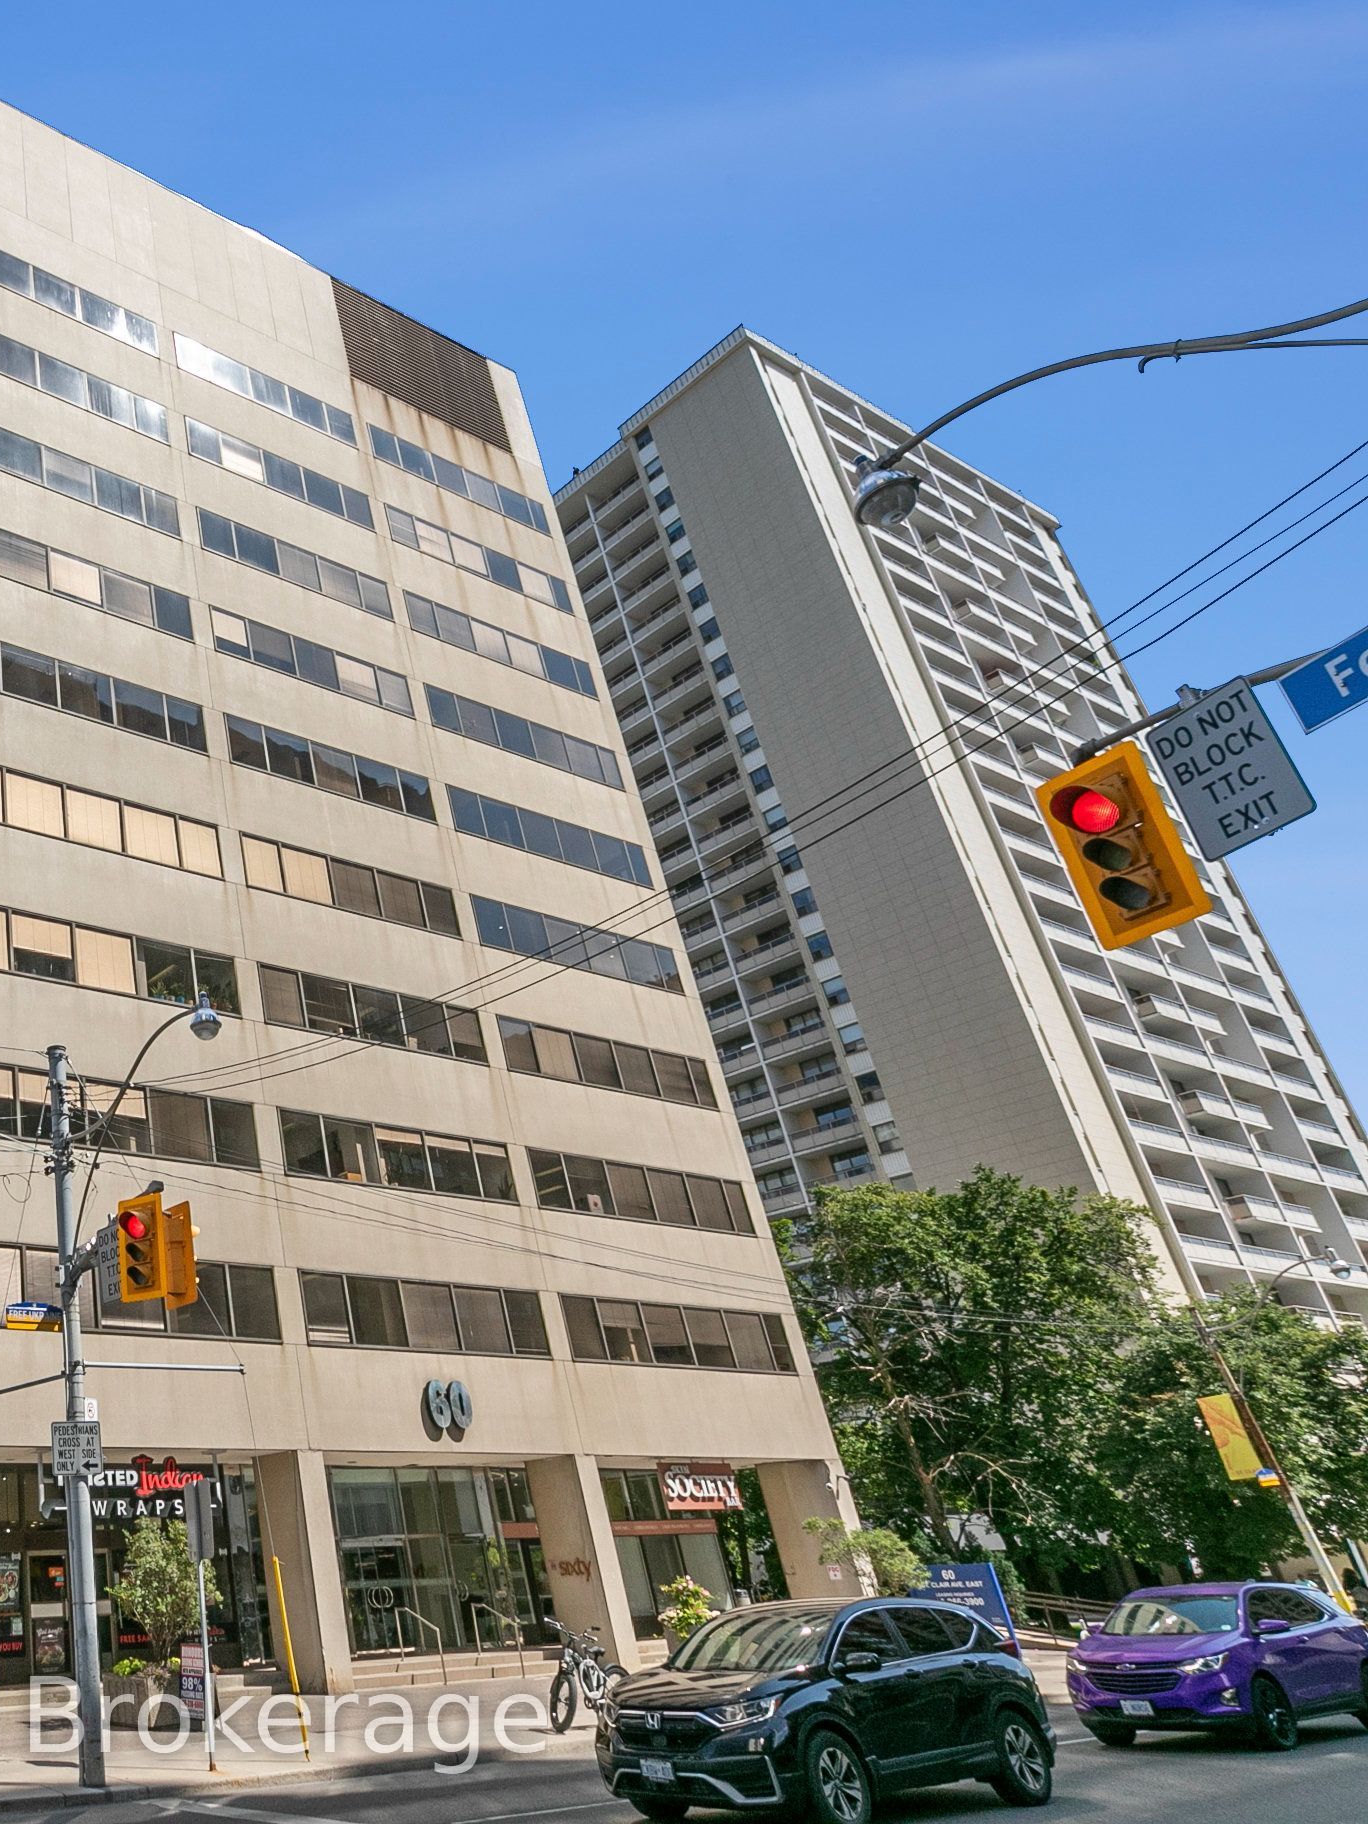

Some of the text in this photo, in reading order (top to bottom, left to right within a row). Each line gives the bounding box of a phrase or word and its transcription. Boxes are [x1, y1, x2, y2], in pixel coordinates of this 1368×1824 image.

[1155, 689, 1252, 760] DO NOT
[1173, 721, 1264, 786] BLOCK
[1202, 763, 1266, 805] T.T.C.
[1218, 790, 1279, 838] EXIT
[99, 1234, 108, 1247] DO
[101, 1246, 120, 1263] BLOC
[108, 1281, 121, 1296] EXI
[9, 1310, 29, 1318] FREE
[429, 1380, 473, 1428] 60
[54, 1425, 98, 1436] PEDESTRIANS
[58, 1437, 95, 1448] CROSS AT
[58, 1449, 96, 1459] WEST SIDE
[56, 1461, 75, 1472] ONLY
[664, 1471, 737, 1498] SOCIETY
[92, 1500, 184, 1516] WRAPS
[559, 1557, 591, 1582] sixty
[941, 1569, 956, 1580] 60
[966, 1580, 983, 1588] EAST
[0, 1642, 12, 1651] YOU
[12, 1641, 23, 1650] BUY
[120, 1635, 135, 1643] FREE
[182, 1677, 203, 1692] 98%
